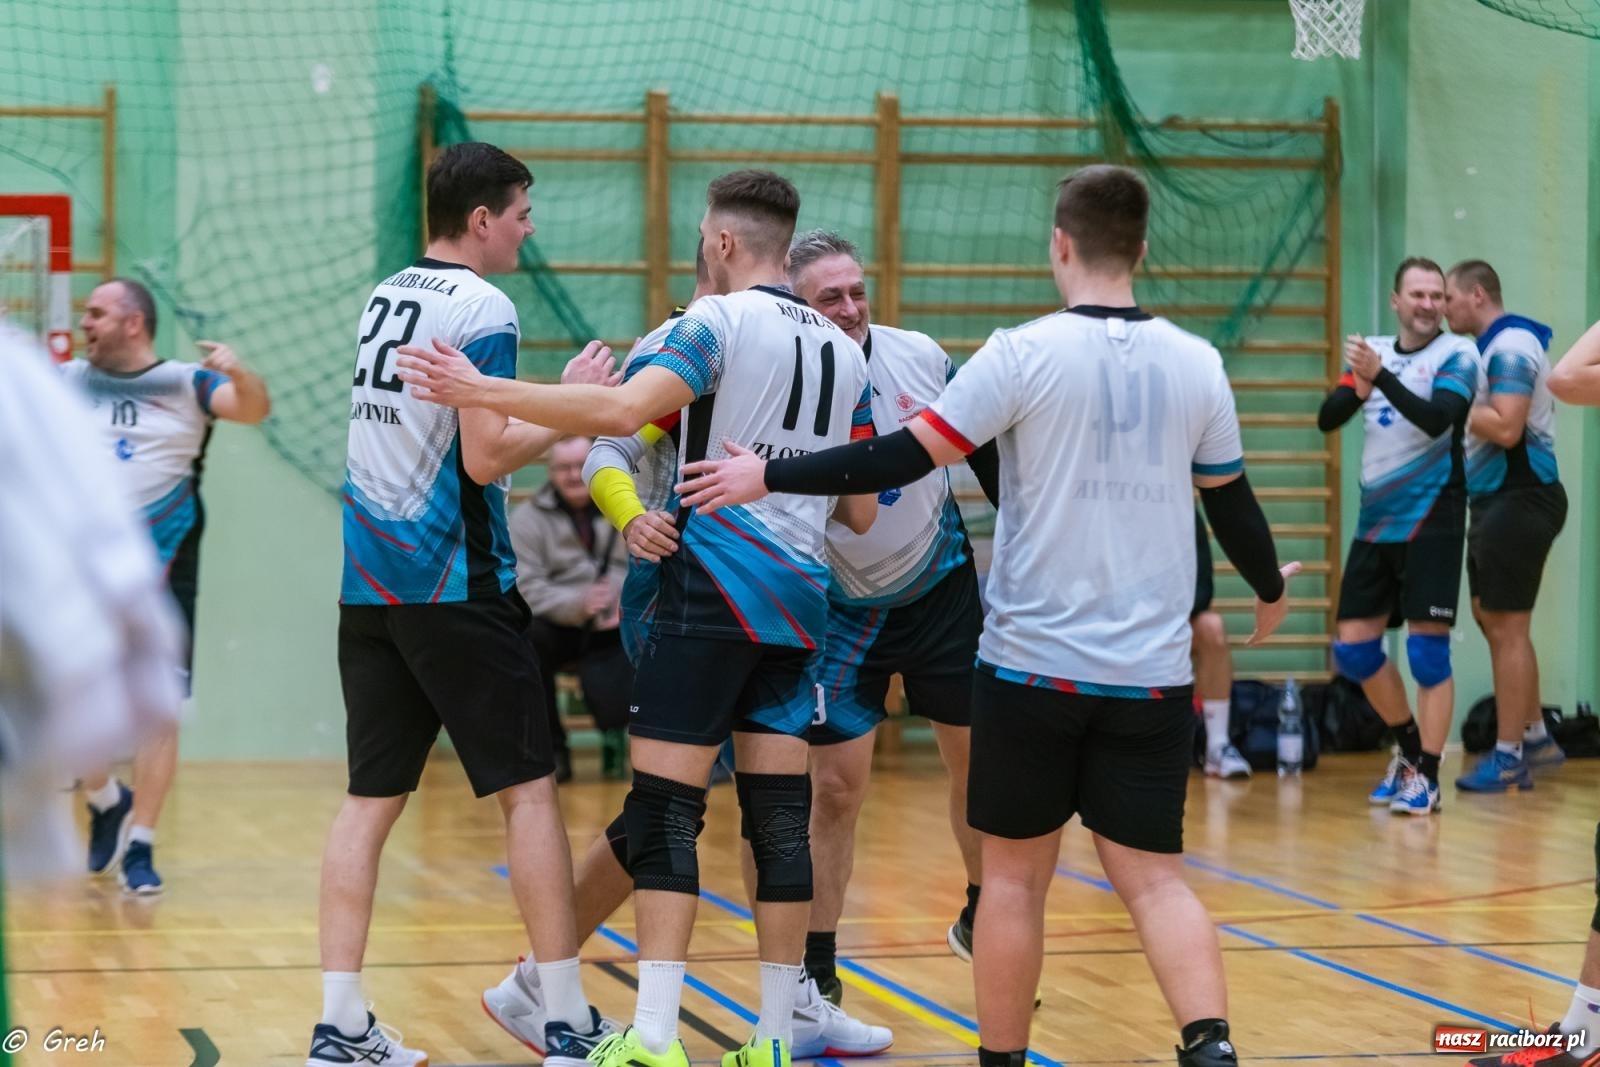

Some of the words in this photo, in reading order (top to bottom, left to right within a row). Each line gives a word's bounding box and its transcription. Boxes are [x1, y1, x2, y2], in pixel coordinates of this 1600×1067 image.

[352, 296, 422, 393] 22
[111, 399, 137, 427] 10
[782, 335, 836, 437] 11
[752, 442, 813, 461] ZŁOT
